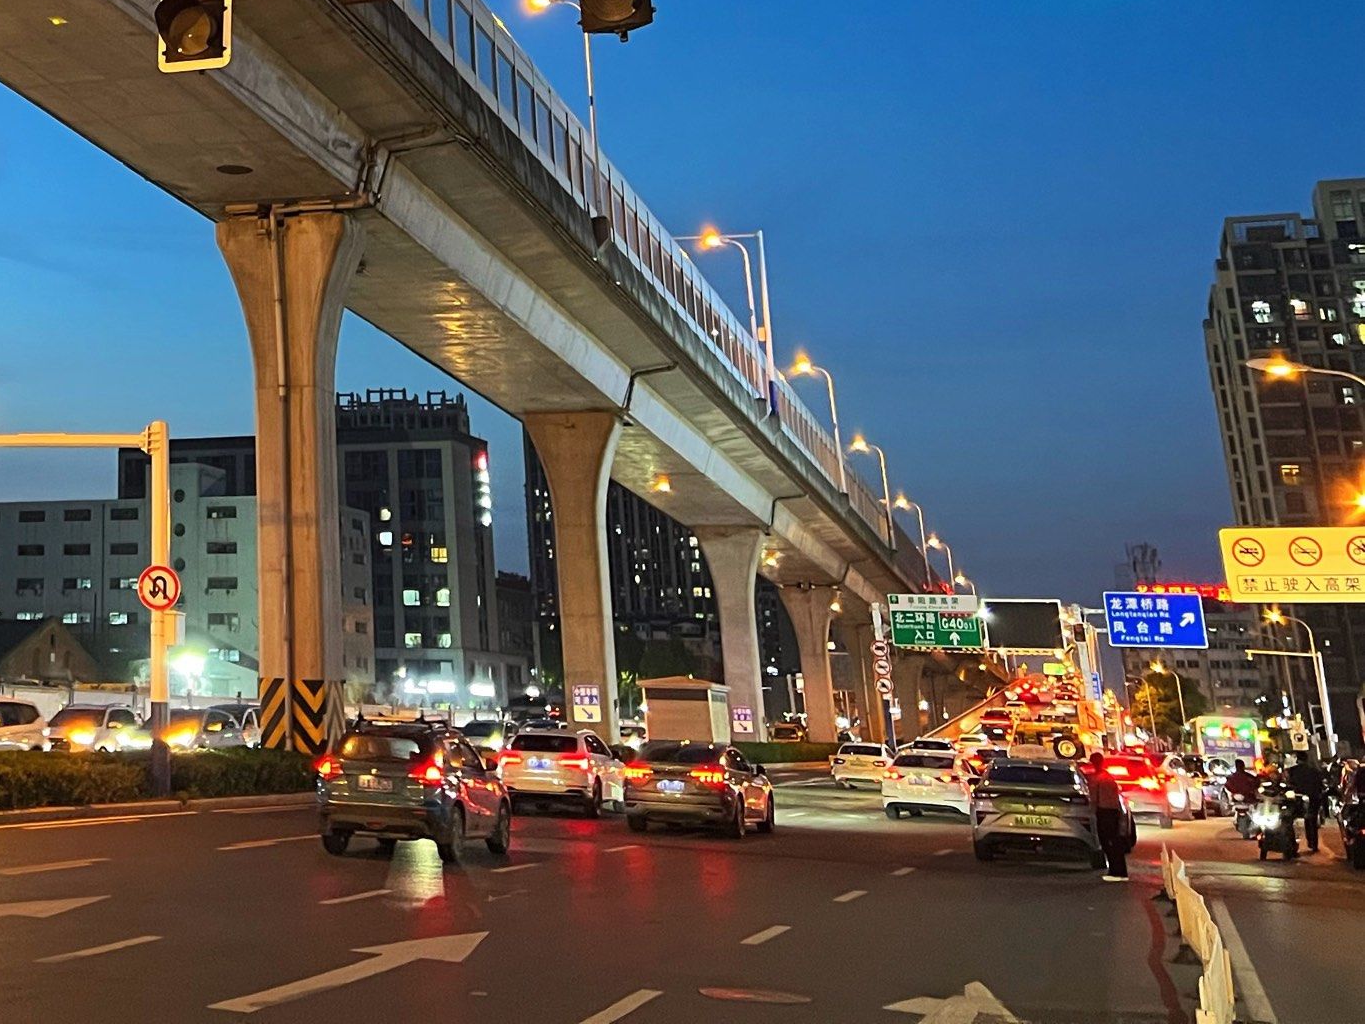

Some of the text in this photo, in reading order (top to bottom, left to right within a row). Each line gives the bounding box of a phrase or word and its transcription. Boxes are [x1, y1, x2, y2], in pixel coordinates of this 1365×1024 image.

[1243, 577, 1361, 592] 禁止驶入高架
[1109, 597, 1169, 611] 龙潭桥路
[895, 612, 935, 624] 北二环路
[915, 630, 935, 640] 入口
